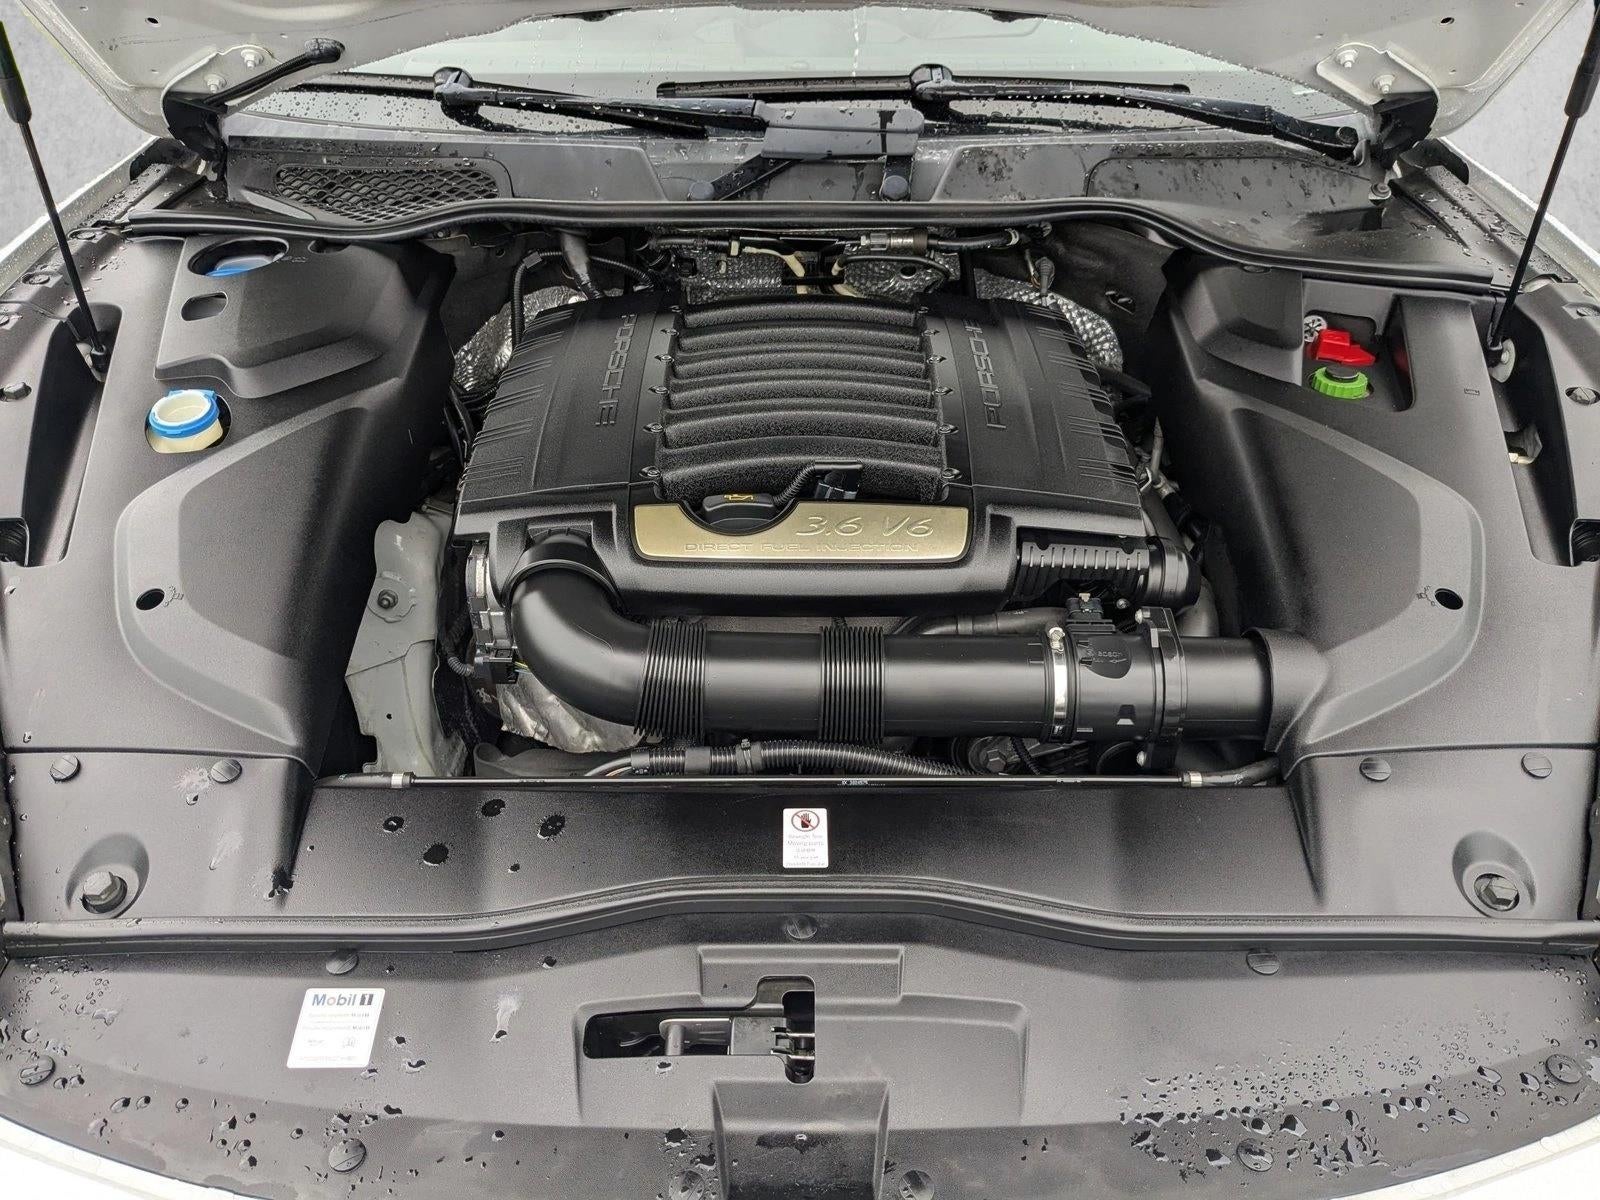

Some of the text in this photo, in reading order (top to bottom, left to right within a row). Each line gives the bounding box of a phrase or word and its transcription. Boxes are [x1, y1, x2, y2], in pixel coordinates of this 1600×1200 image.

[595, 313, 638, 426] PORSCHE
[796, 516, 934, 537] 3.6 V6
[683, 542, 919, 553] DIRECT FUEL INJECTION
[312, 993, 374, 1006] Mobil 1
